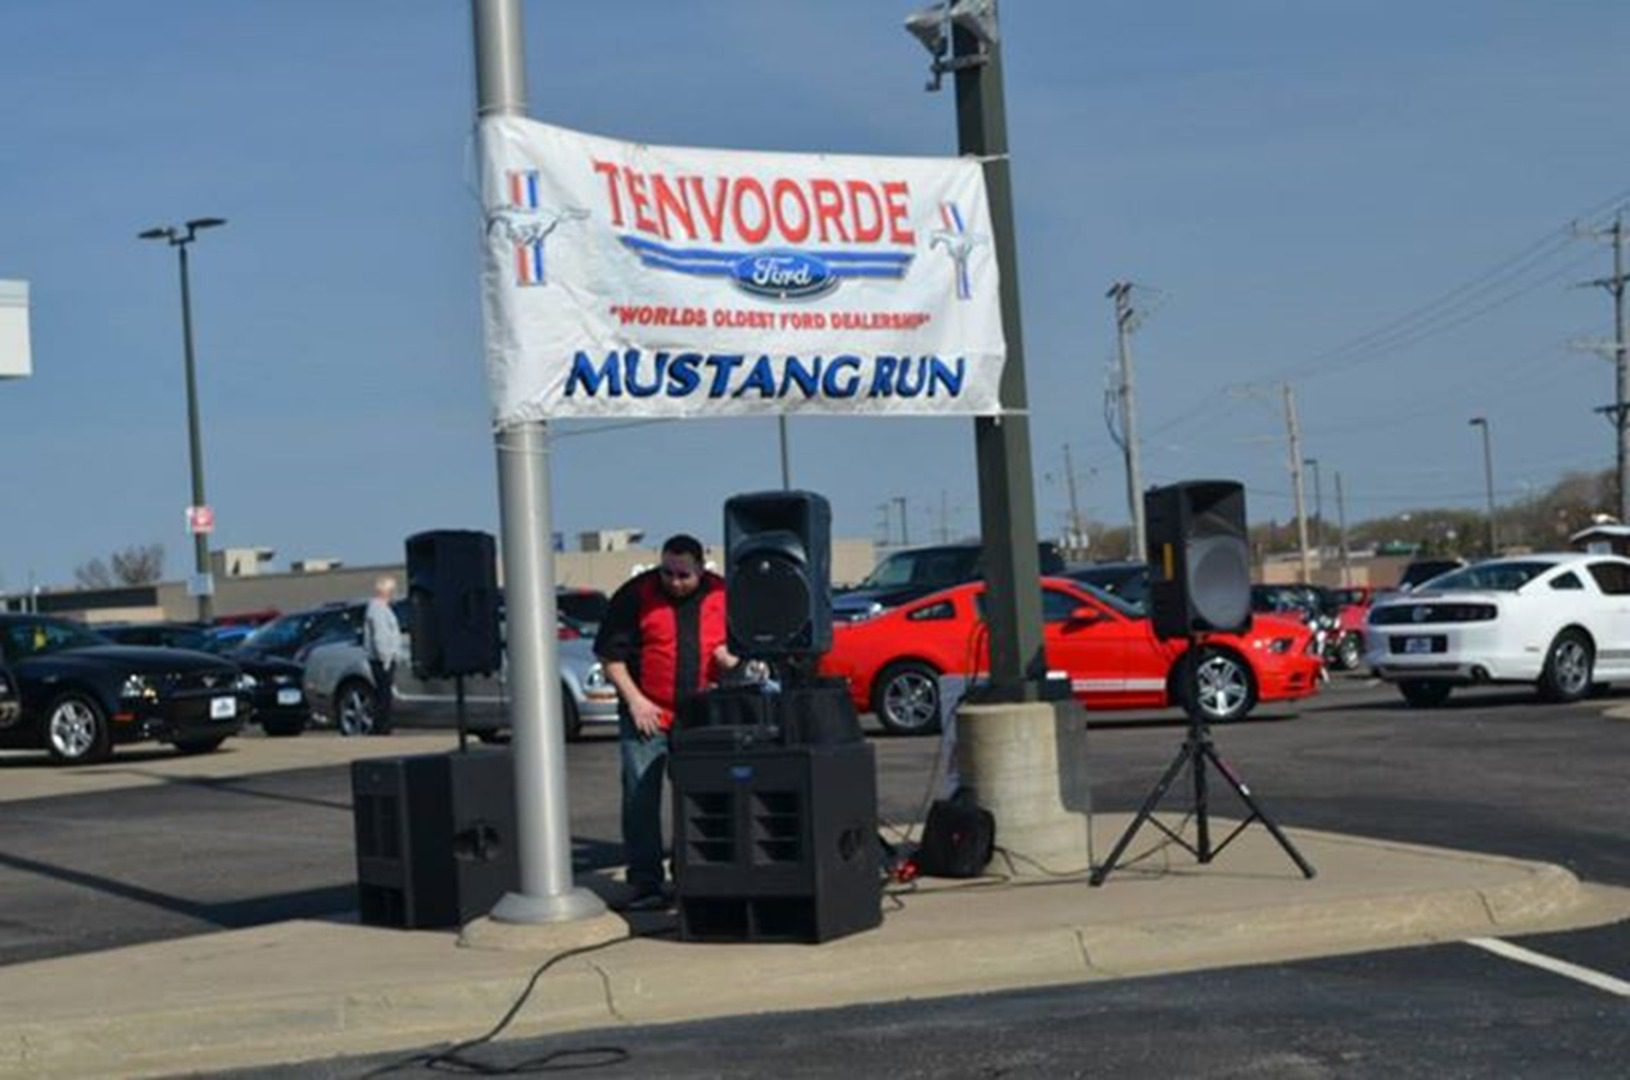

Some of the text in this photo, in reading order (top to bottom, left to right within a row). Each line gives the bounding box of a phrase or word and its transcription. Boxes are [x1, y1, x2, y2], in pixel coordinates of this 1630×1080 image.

[593, 160, 916, 245] TENVOORDE
[752, 256, 813, 285] Ford
[713, 308, 774, 328] OLDEST
[781, 312, 825, 330] FORD
[564, 348, 965, 398] MUSTANG RUN
